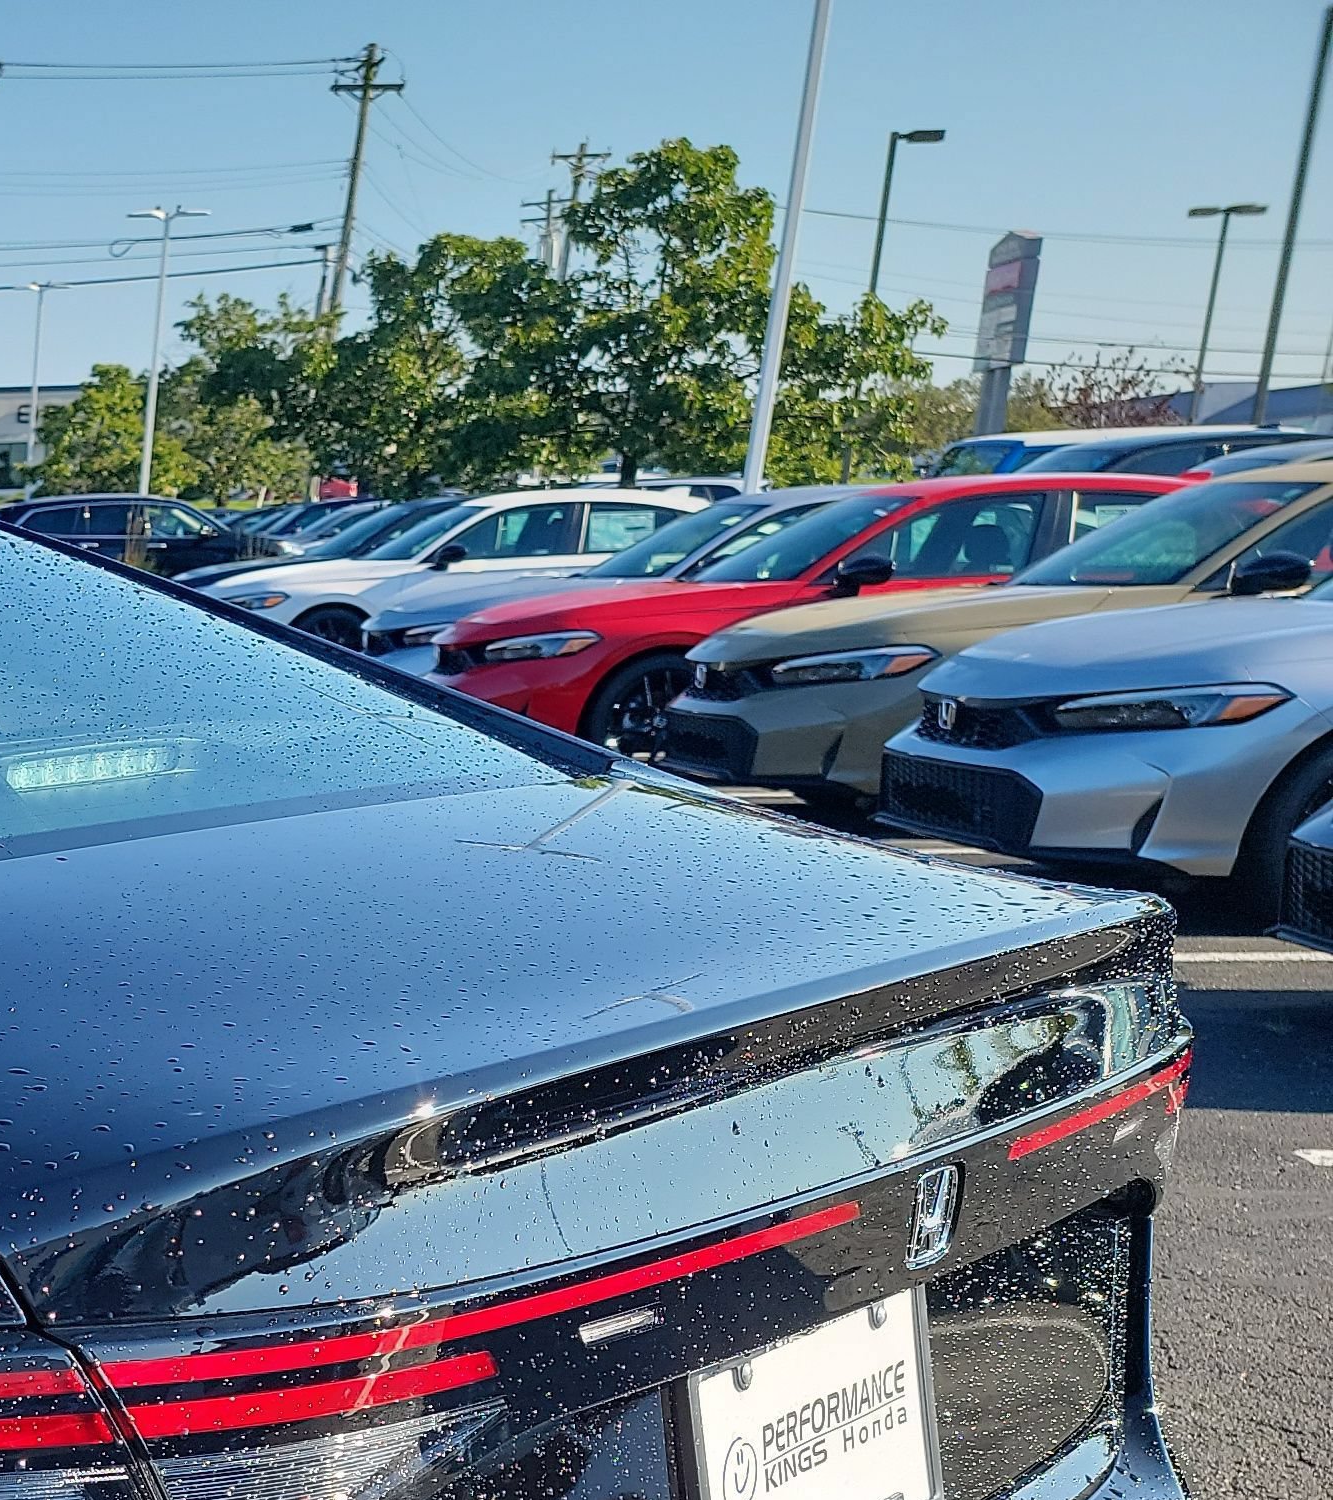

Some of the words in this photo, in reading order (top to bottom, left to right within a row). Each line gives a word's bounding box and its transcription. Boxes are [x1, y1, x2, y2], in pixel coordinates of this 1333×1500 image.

[763, 1359, 905, 1460] PERFORMANCE
[764, 1438, 828, 1492] KINGS
[842, 1405, 907, 1453] Honda
